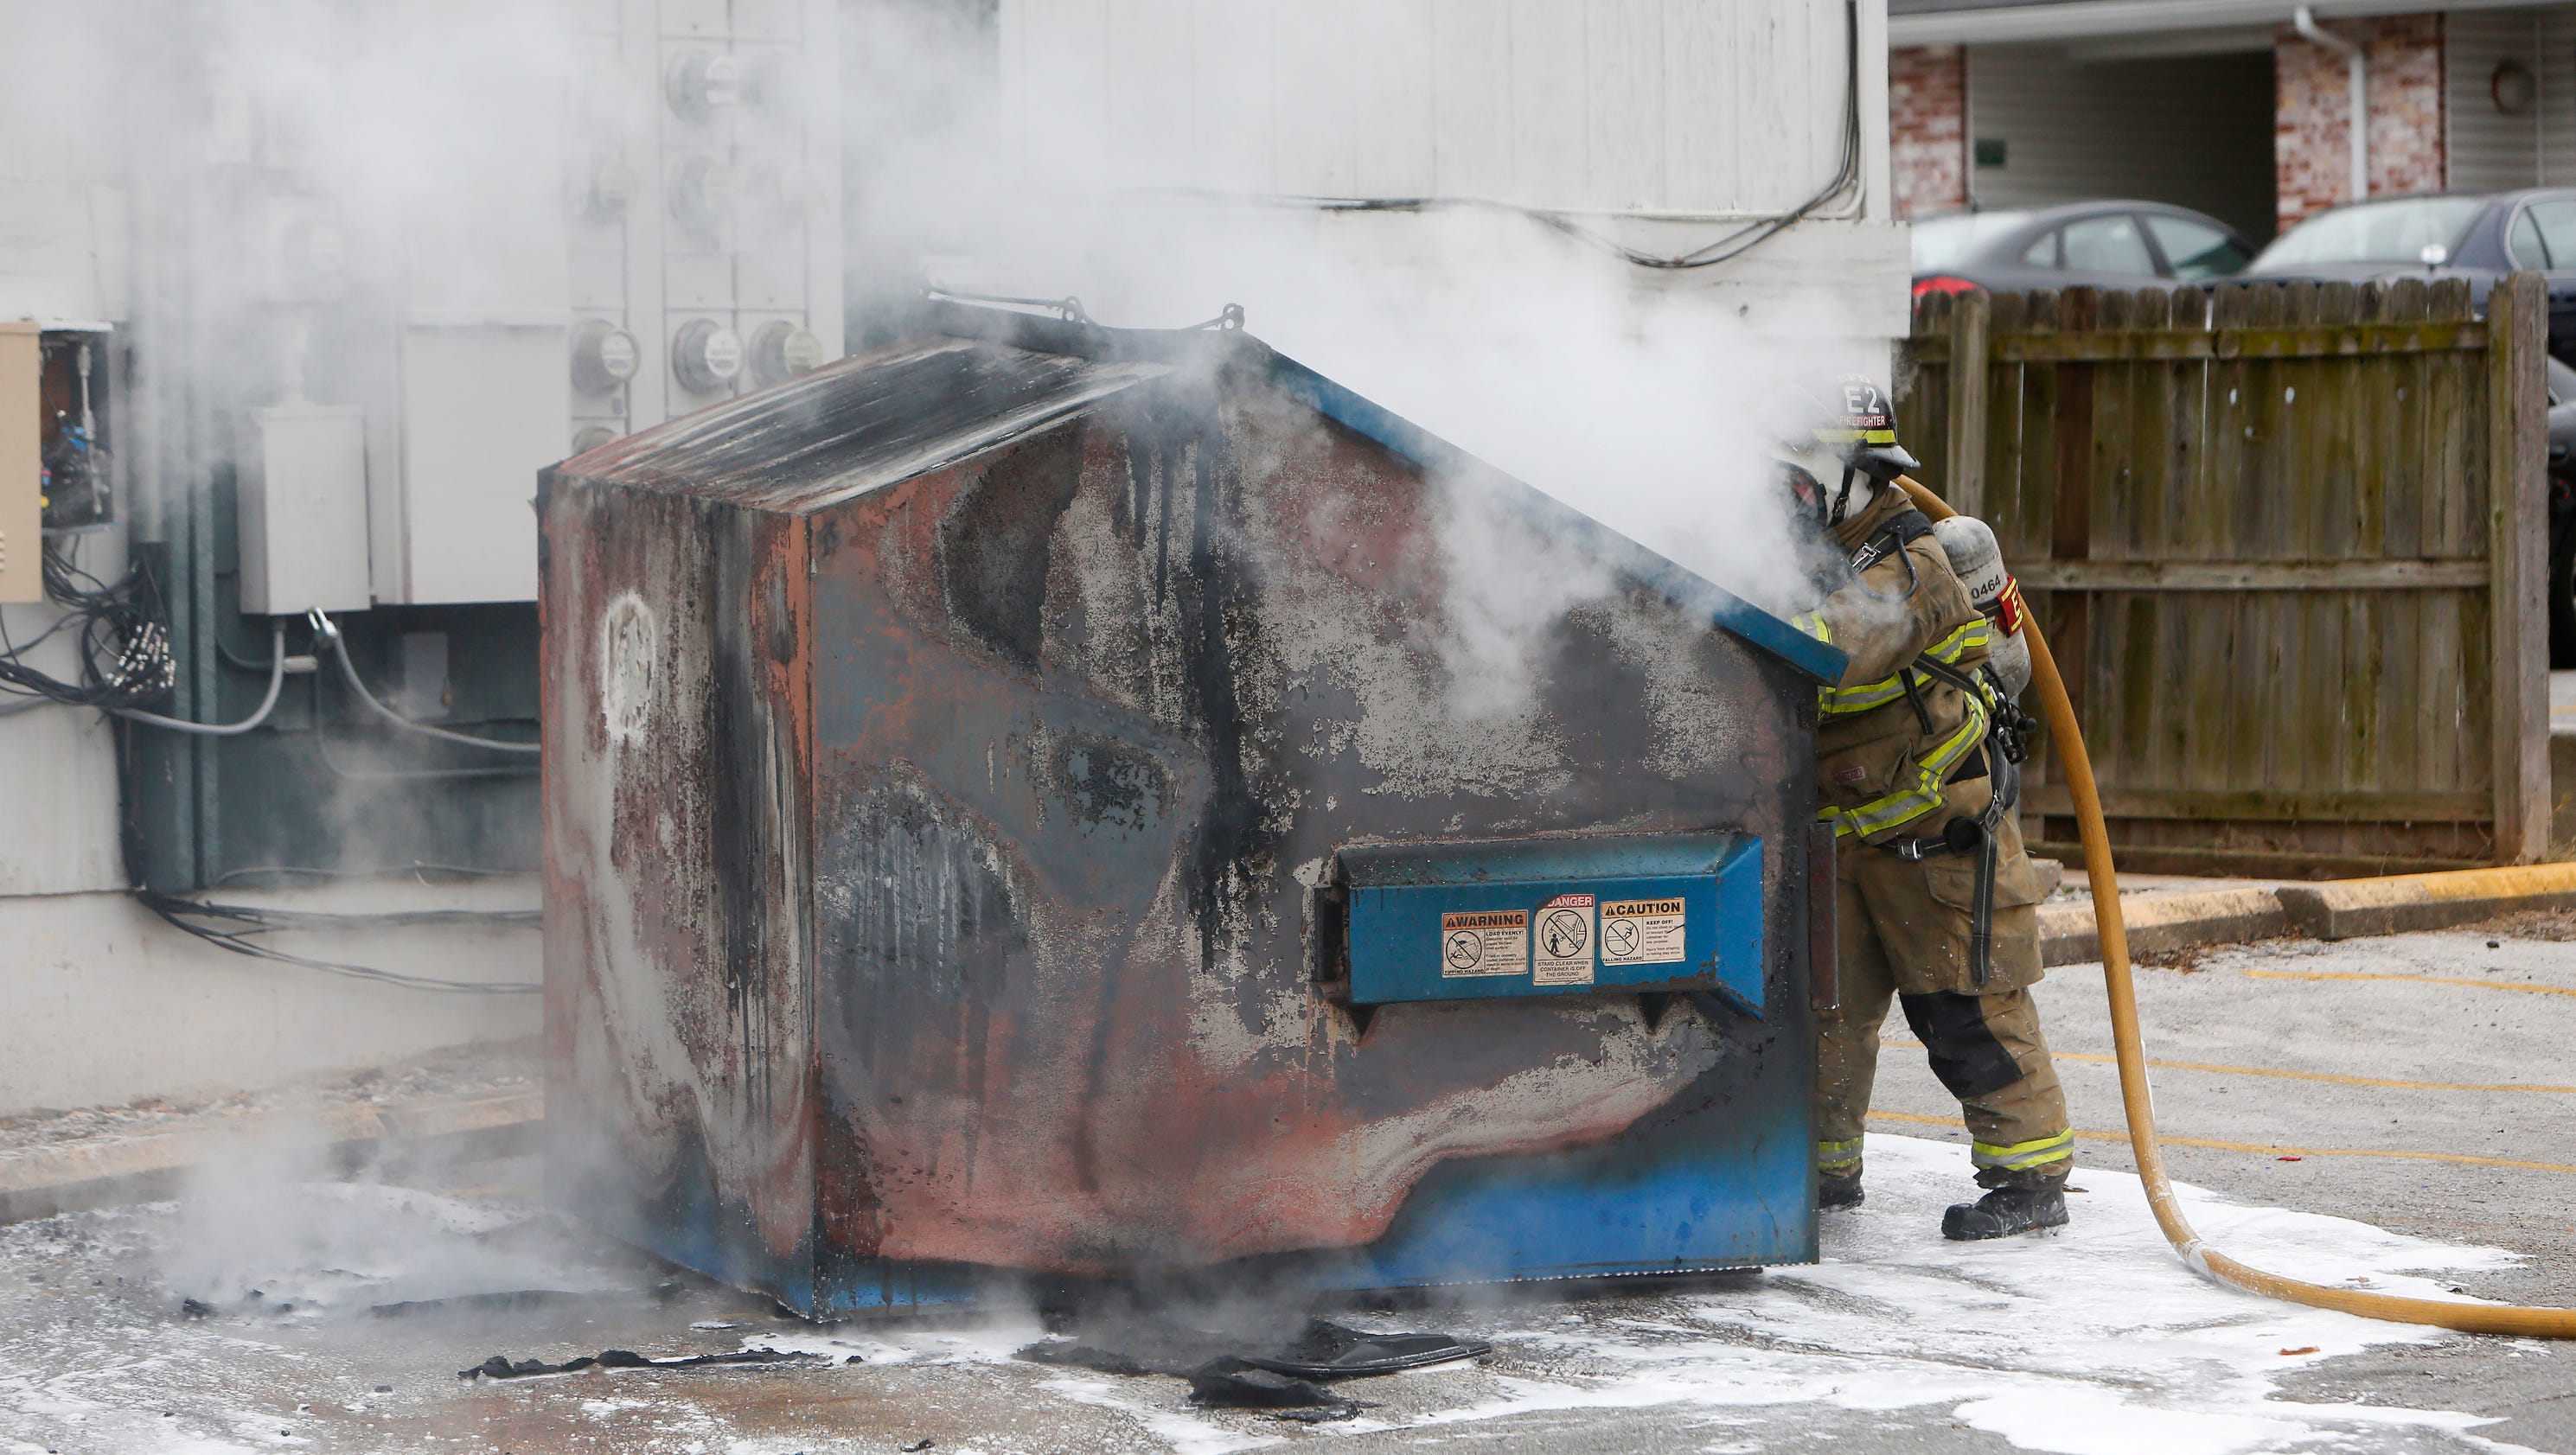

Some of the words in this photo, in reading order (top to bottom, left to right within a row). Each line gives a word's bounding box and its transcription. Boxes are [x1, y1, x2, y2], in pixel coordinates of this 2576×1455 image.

[1844, 386, 1880, 413] E2
[1839, 416, 1886, 426] FIREFIGHTER
[1972, 574, 2001, 599] 0464
[1617, 903, 1680, 915] CAUTION
[1456, 915, 1524, 927] WARNING
